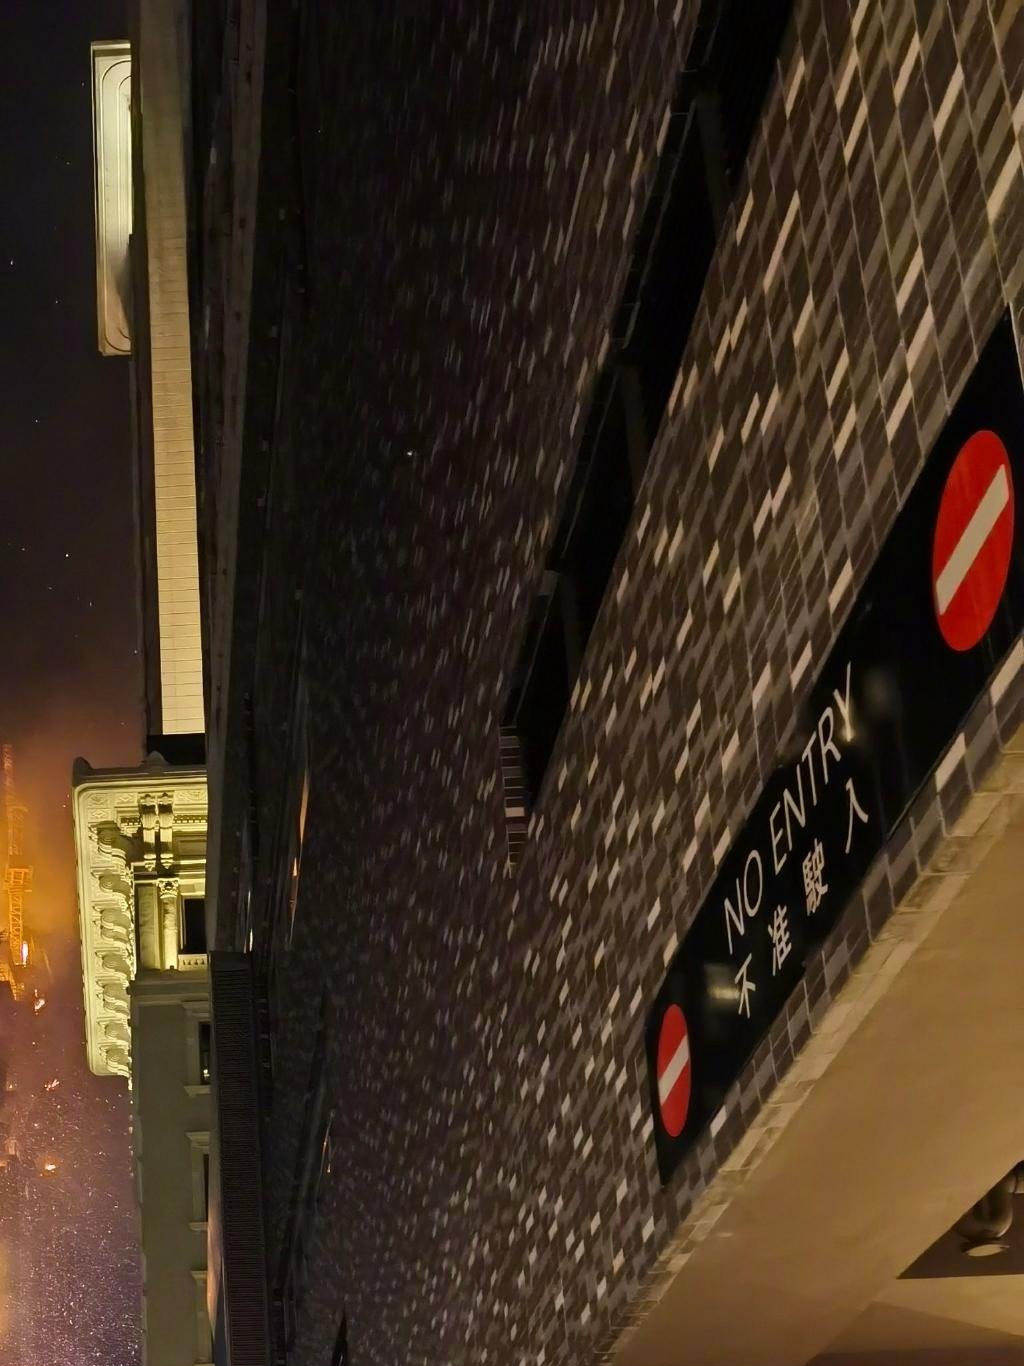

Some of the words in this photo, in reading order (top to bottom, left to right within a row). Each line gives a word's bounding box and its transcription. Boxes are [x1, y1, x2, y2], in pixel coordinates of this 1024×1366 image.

[724, 849, 764, 955] NO
[768, 660, 853, 876] ENTRY
[734, 776, 869, 1019] 不准駛入
